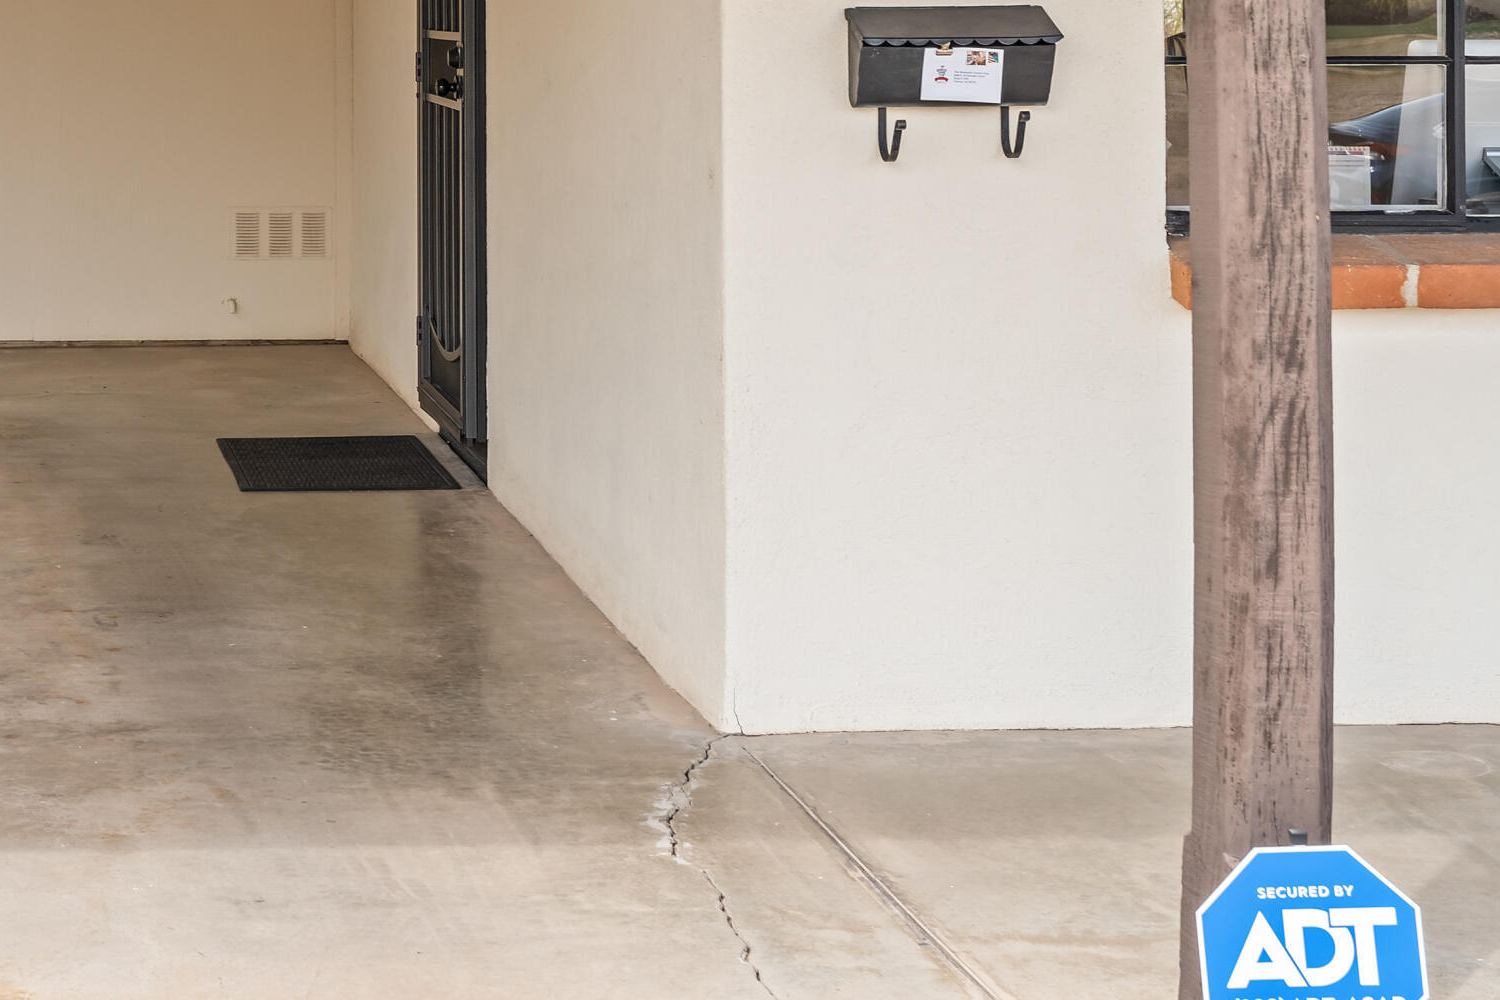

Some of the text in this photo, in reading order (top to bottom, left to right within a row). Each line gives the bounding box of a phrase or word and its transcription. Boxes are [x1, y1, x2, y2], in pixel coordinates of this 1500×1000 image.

[1256, 884, 1354, 900] SECURED BY
[1226, 906, 1398, 989] ADT
